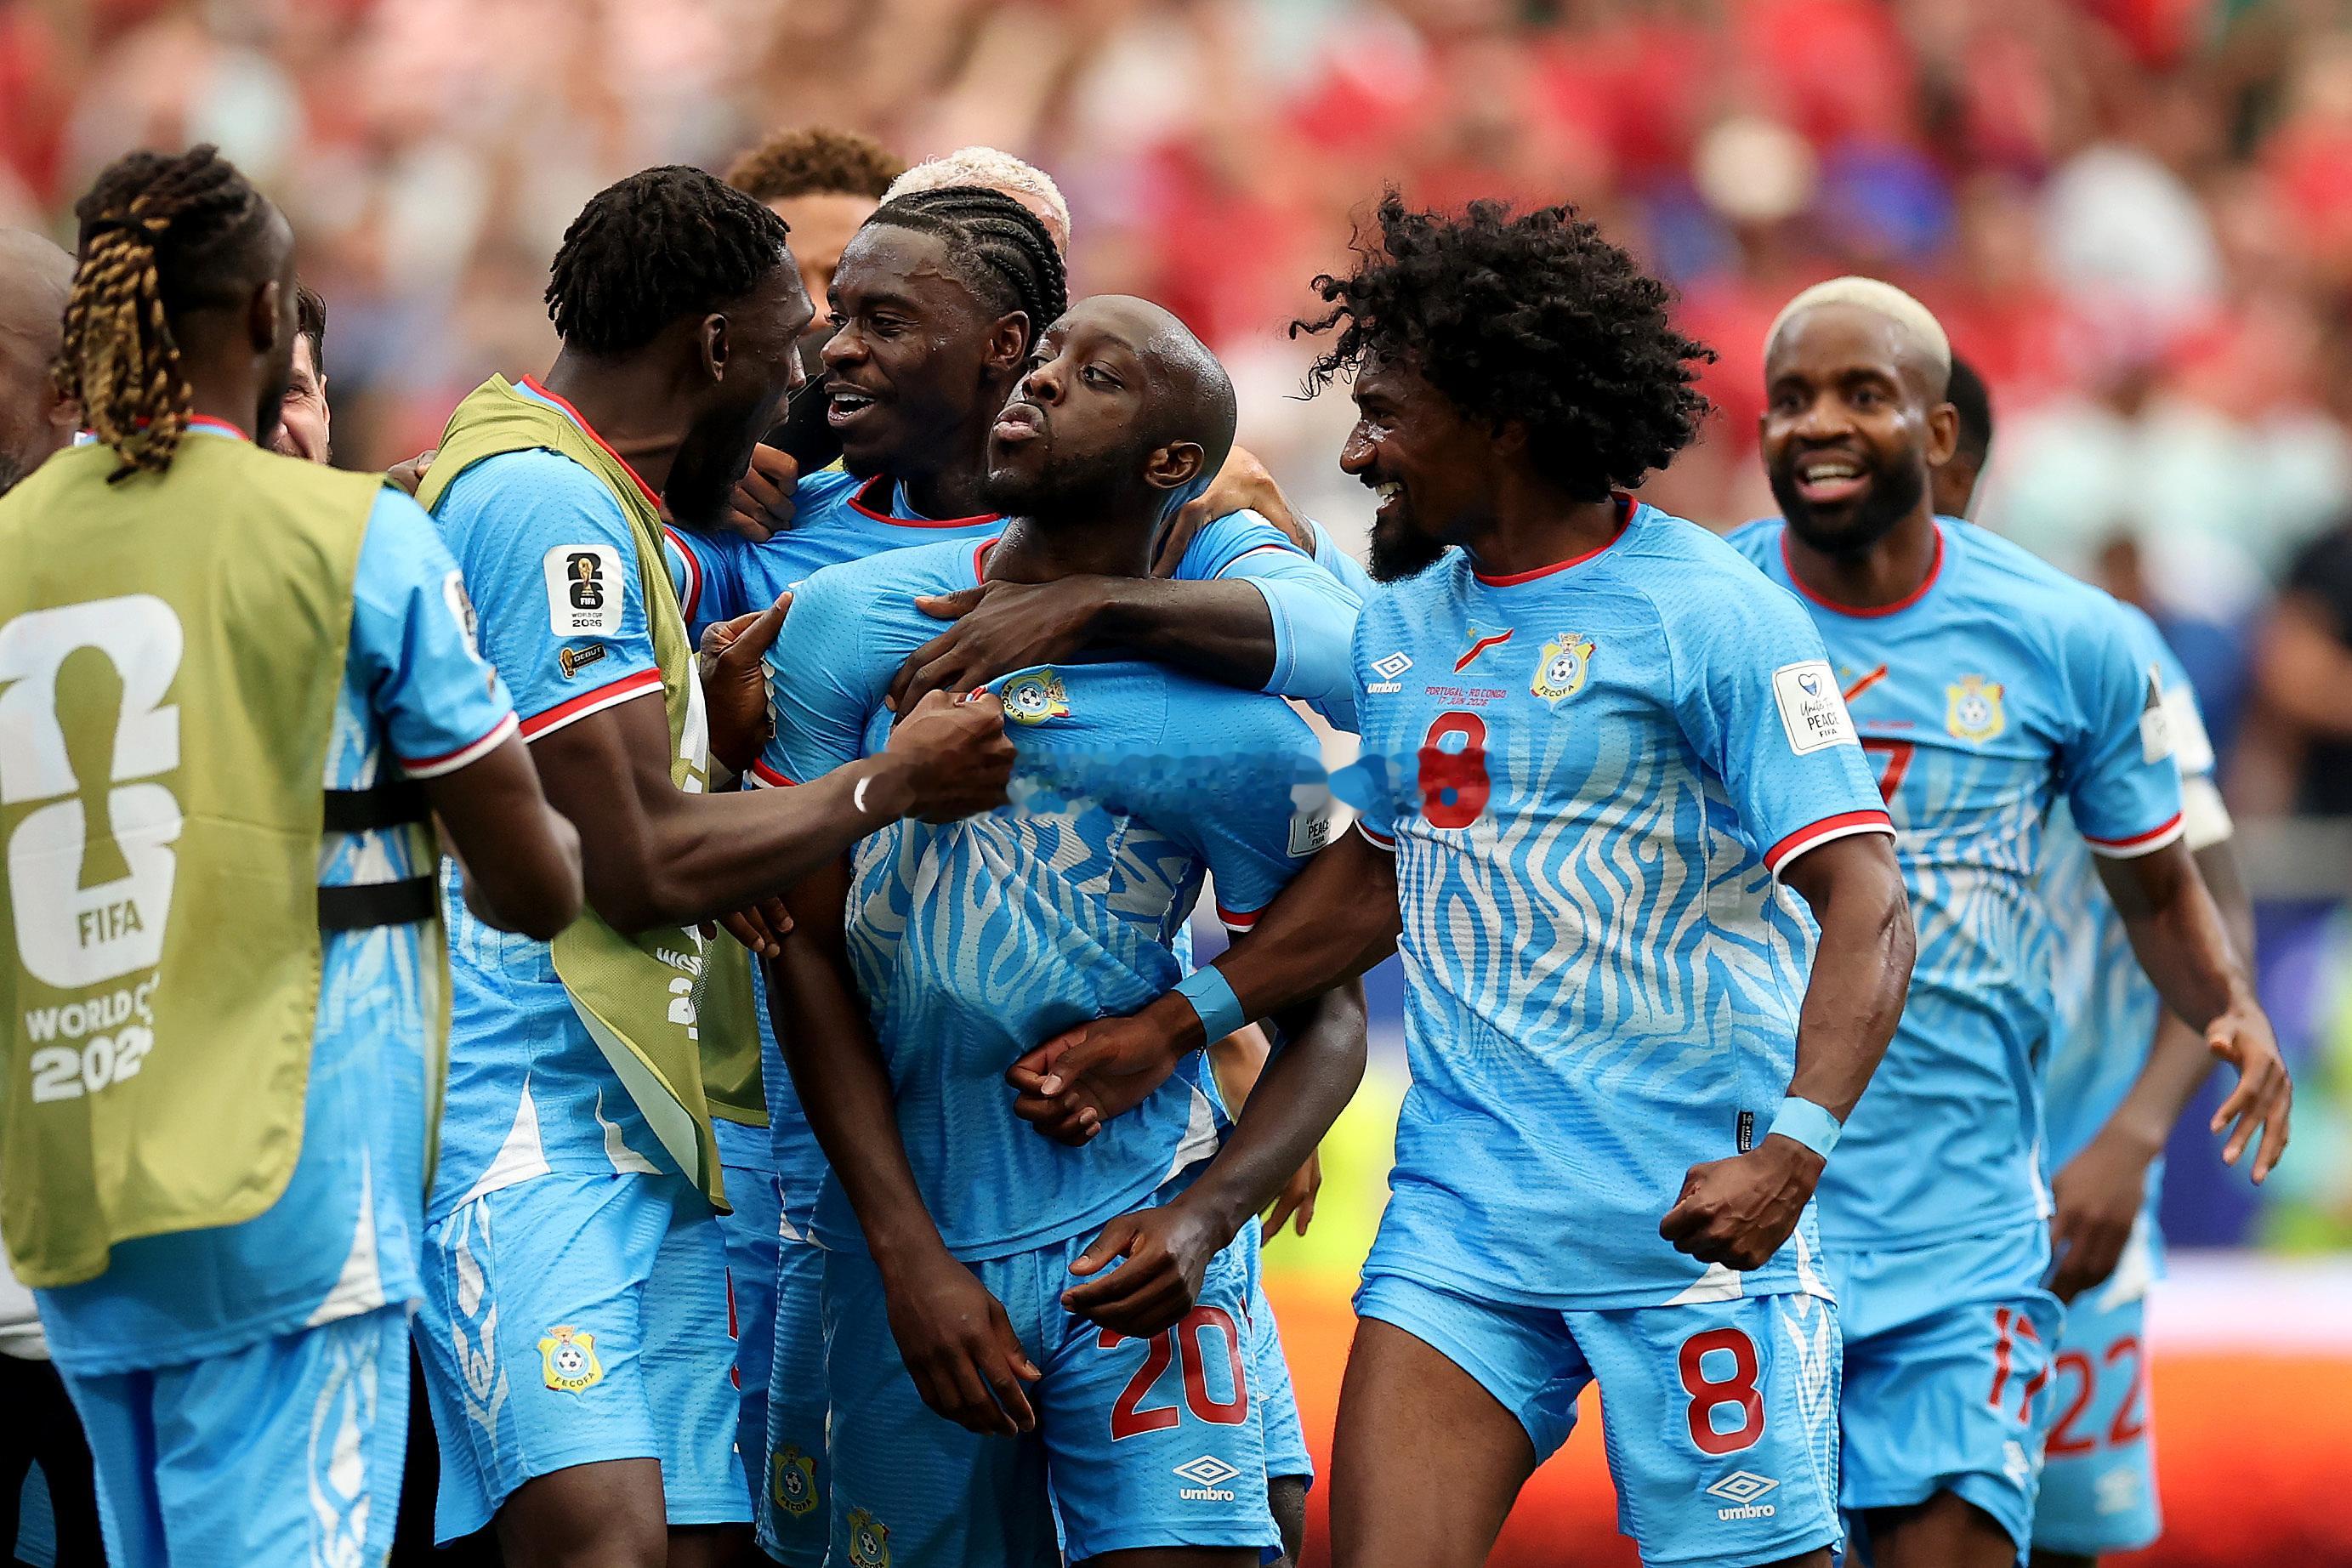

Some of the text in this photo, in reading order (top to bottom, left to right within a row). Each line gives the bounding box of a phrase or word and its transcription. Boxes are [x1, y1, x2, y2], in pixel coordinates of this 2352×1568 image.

[580, 597, 596, 605] FIFA
[572, 619, 602, 628] 2026
[1367, 681, 1402, 694] umbro
[1425, 686, 1463, 696] PORTUGAL
[1481, 689, 1508, 698] CONGO
[1540, 685, 1574, 697] FECOFA
[1003, 685, 1024, 719] FECOFA
[1800, 700, 1824, 716] Unite
[1820, 728, 1838, 738] FIFA
[77, 899, 144, 950] FIFA
[25, 988, 134, 1042] WORLD
[29, 1024, 155, 1104] 202
[554, 1372, 594, 1388] FECOFA
[1096, 1304, 1249, 1443] 20
[1678, 1327, 1766, 1457] 8
[2044, 1332, 2146, 1461] 22
[1179, 1486, 1235, 1503] umbro
[1718, 1503, 1775, 1522] umbro
